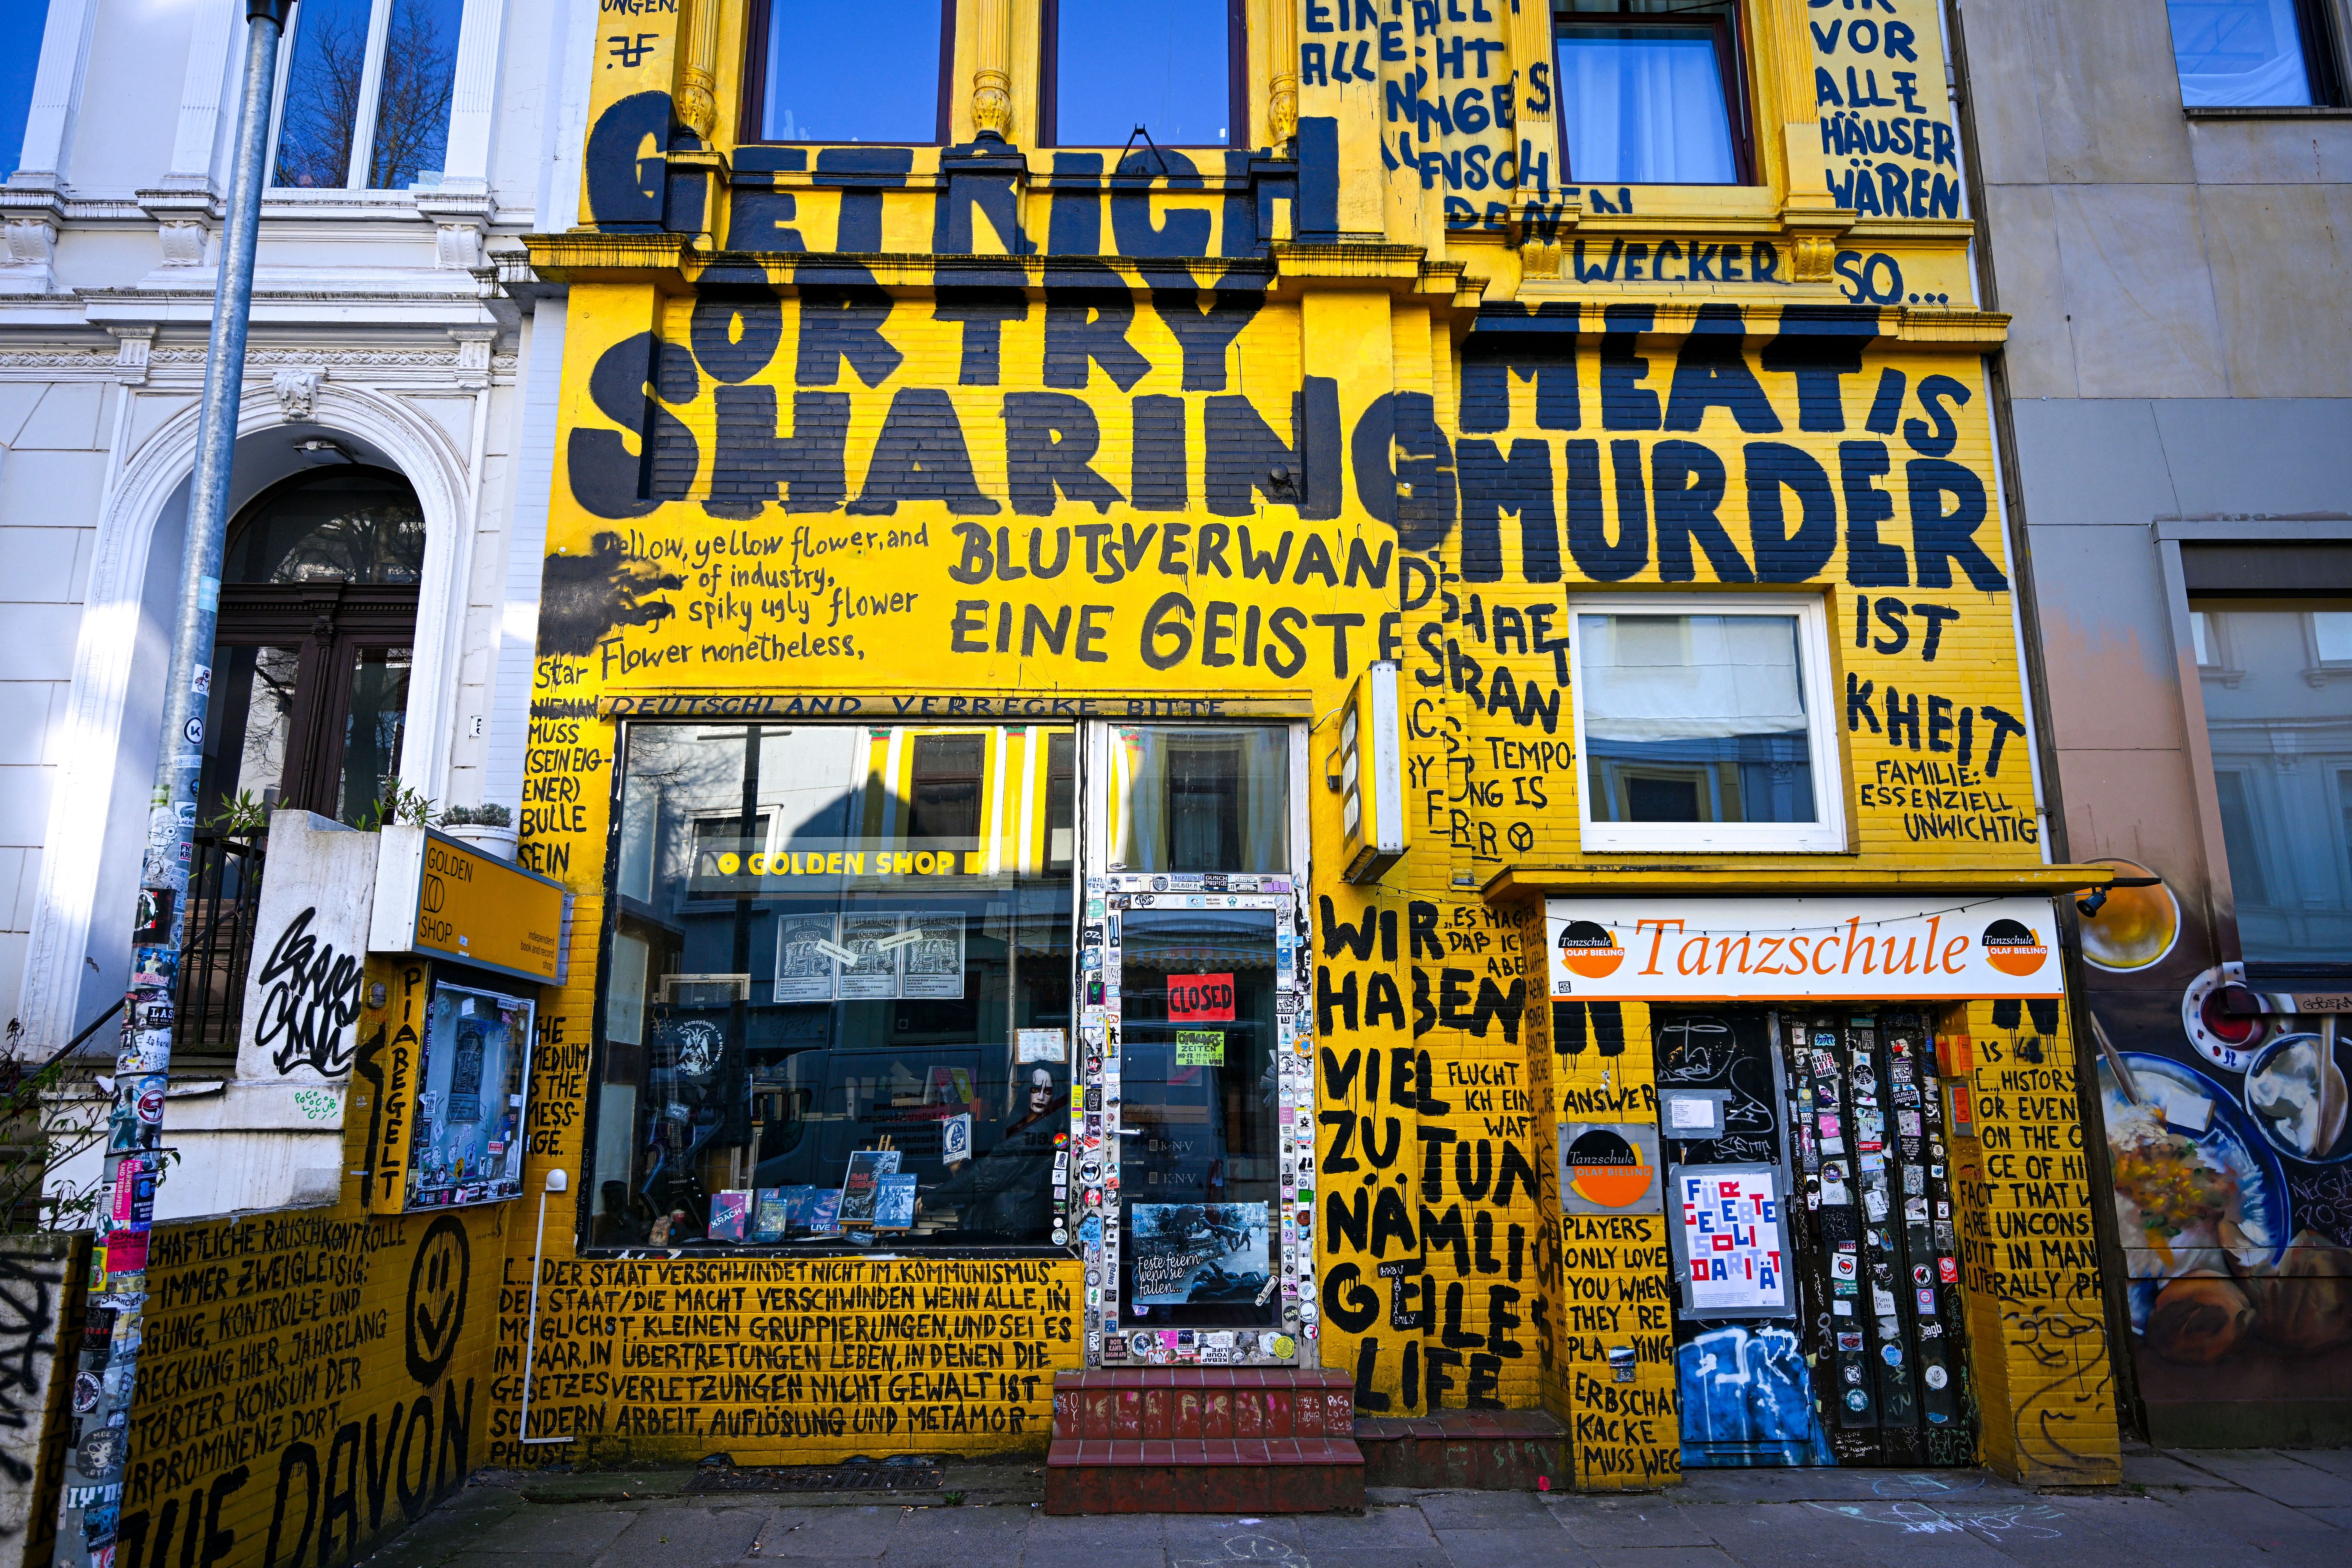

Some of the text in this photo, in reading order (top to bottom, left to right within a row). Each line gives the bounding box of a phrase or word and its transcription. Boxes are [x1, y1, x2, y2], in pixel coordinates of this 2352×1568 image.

[1810, 19, 1918, 63] VOR
[1815, 65, 1928, 114] ALLE
[1820, 110, 1957, 170] HÄUSER
[1826, 158, 1959, 219] WÄREN
[1573, 238, 1779, 283] WECKER
[690, 254, 1276, 392] OR TRY
[1458, 301, 1972, 458] MEAT IS
[567, 332, 1459, 552] SHARING
[1457, 438, 2008, 591] MURDER
[695, 529, 784, 568] yellow
[887, 522, 928, 548] and
[699, 564, 722, 597] of
[732, 562, 835, 596] industry,
[689, 586, 918, 631] spiky ugly flower
[951, 599, 1114, 663] EINE
[1856, 595, 1960, 662] IST
[600, 637, 693, 679] Flower
[609, 696, 862, 715] DEUTSCHLAND
[1127, 700, 1225, 716] BITTE
[528, 724, 580, 745] MUSS
[1861, 784, 2013, 813] ESSENZIELL
[519, 803, 587, 838] BULLE
[1904, 812, 2038, 844] UNWICHTIG
[428, 848, 473, 883] GOLDEN
[518, 843, 570, 874] SEIN
[748, 851, 955, 876] GOLDEN SHOP
[420, 916, 452, 943] SHOP
[803, 918, 831, 931] PETROZZA
[848, 916, 895, 930] MILLE PETROZZA
[1319, 895, 1445, 963] WIR
[521, 940, 531, 952] book
[541, 949, 554, 958] record
[528, 930, 554, 946] independent
[820, 944, 842, 957] Vorverkauf
[882, 937, 905, 947] Vorverkauf
[1561, 938, 1611, 946] Tanzschule
[1634, 916, 1971, 976] Tanzschule
[1984, 935, 2033, 944] Tanzschule
[543, 960, 552, 972] shop
[1169, 984, 1232, 1013] CLOSED
[1317, 965, 1527, 1044] HABEN
[684, 1019, 716, 1031] homophobia
[1812, 1054, 1832, 1064] NAZIS
[1815, 1060, 1834, 1070] AUFS
[1816, 1067, 1836, 1077] MAUL!
[546, 1071, 581, 1100] THE
[1322, 1047, 1451, 1116] VIEL
[1447, 1062, 1519, 1086] FLUCHT
[1465, 1089, 1493, 1111] ICH
[1563, 1084, 1658, 1112] ANSWER
[1895, 1096, 1917, 1104] PIEFKE
[1980, 1096, 2076, 1120] OR EVEN
[1983, 1126, 2060, 1150] ON THE
[1318, 1109, 1402, 1174] ZU
[1416, 1125, 1541, 1212] TUN
[1570, 1149, 1635, 1165] Tanzschule
[2025, 1155, 2053, 1180] OF
[125, 1162, 133, 1193] ALARMED
[851, 1173, 869, 1182] IRON
[1577, 1168, 1651, 1176] OLAF BIELING
[115, 1178, 124, 1214] TERRIFIED?
[1687, 1179, 1741, 1209] FÜR
[1959, 1180, 2068, 1208] FACT THAT
[711, 1207, 742, 1228] KRACH
[1563, 1217, 1651, 1241] PLAYERS
[1964, 1211, 1991, 1238] ARE
[1137, 1255, 1165, 1271] Feste
[1564, 1246, 1667, 1271] ONLY LOVE
[161, 1268, 227, 1308] IMMER
[590, 1261, 865, 1290] STAAT VERSCHWINDET NICHT
[1138, 1266, 1185, 1281] wenn sie
[1968, 1270, 2061, 1302] LITERALLY
[675, 1284, 1071, 1312] MACHT VERSCHWINDEN WENN IN
[1139, 1279, 1182, 1299] fallen...
[1570, 1276, 1607, 1301] YOU
[1618, 1276, 1670, 1302] WHEN
[219, 1288, 361, 1338] KONTROLLE UND
[289, 1310, 386, 1364] JAHRELANG
[644, 1314, 1071, 1343] KLEINEN UND SEI ES
[622, 1336, 1052, 1371] ÜBERTRETUNGEN IN DENEN DIE
[234, 1357, 361, 1420] KONSUM DER
[812, 1372, 1041, 1404] NICHT GEWALT IST
[1354, 1338, 1505, 1413] LIFE
[489, 1404, 897, 1439] SONDERN AUFLÖSUNG UND
[1577, 1413, 1657, 1446] KACKE
[264, 1378, 475, 1568] DAVON
[1583, 1445, 1681, 1477] MUSS WEG
